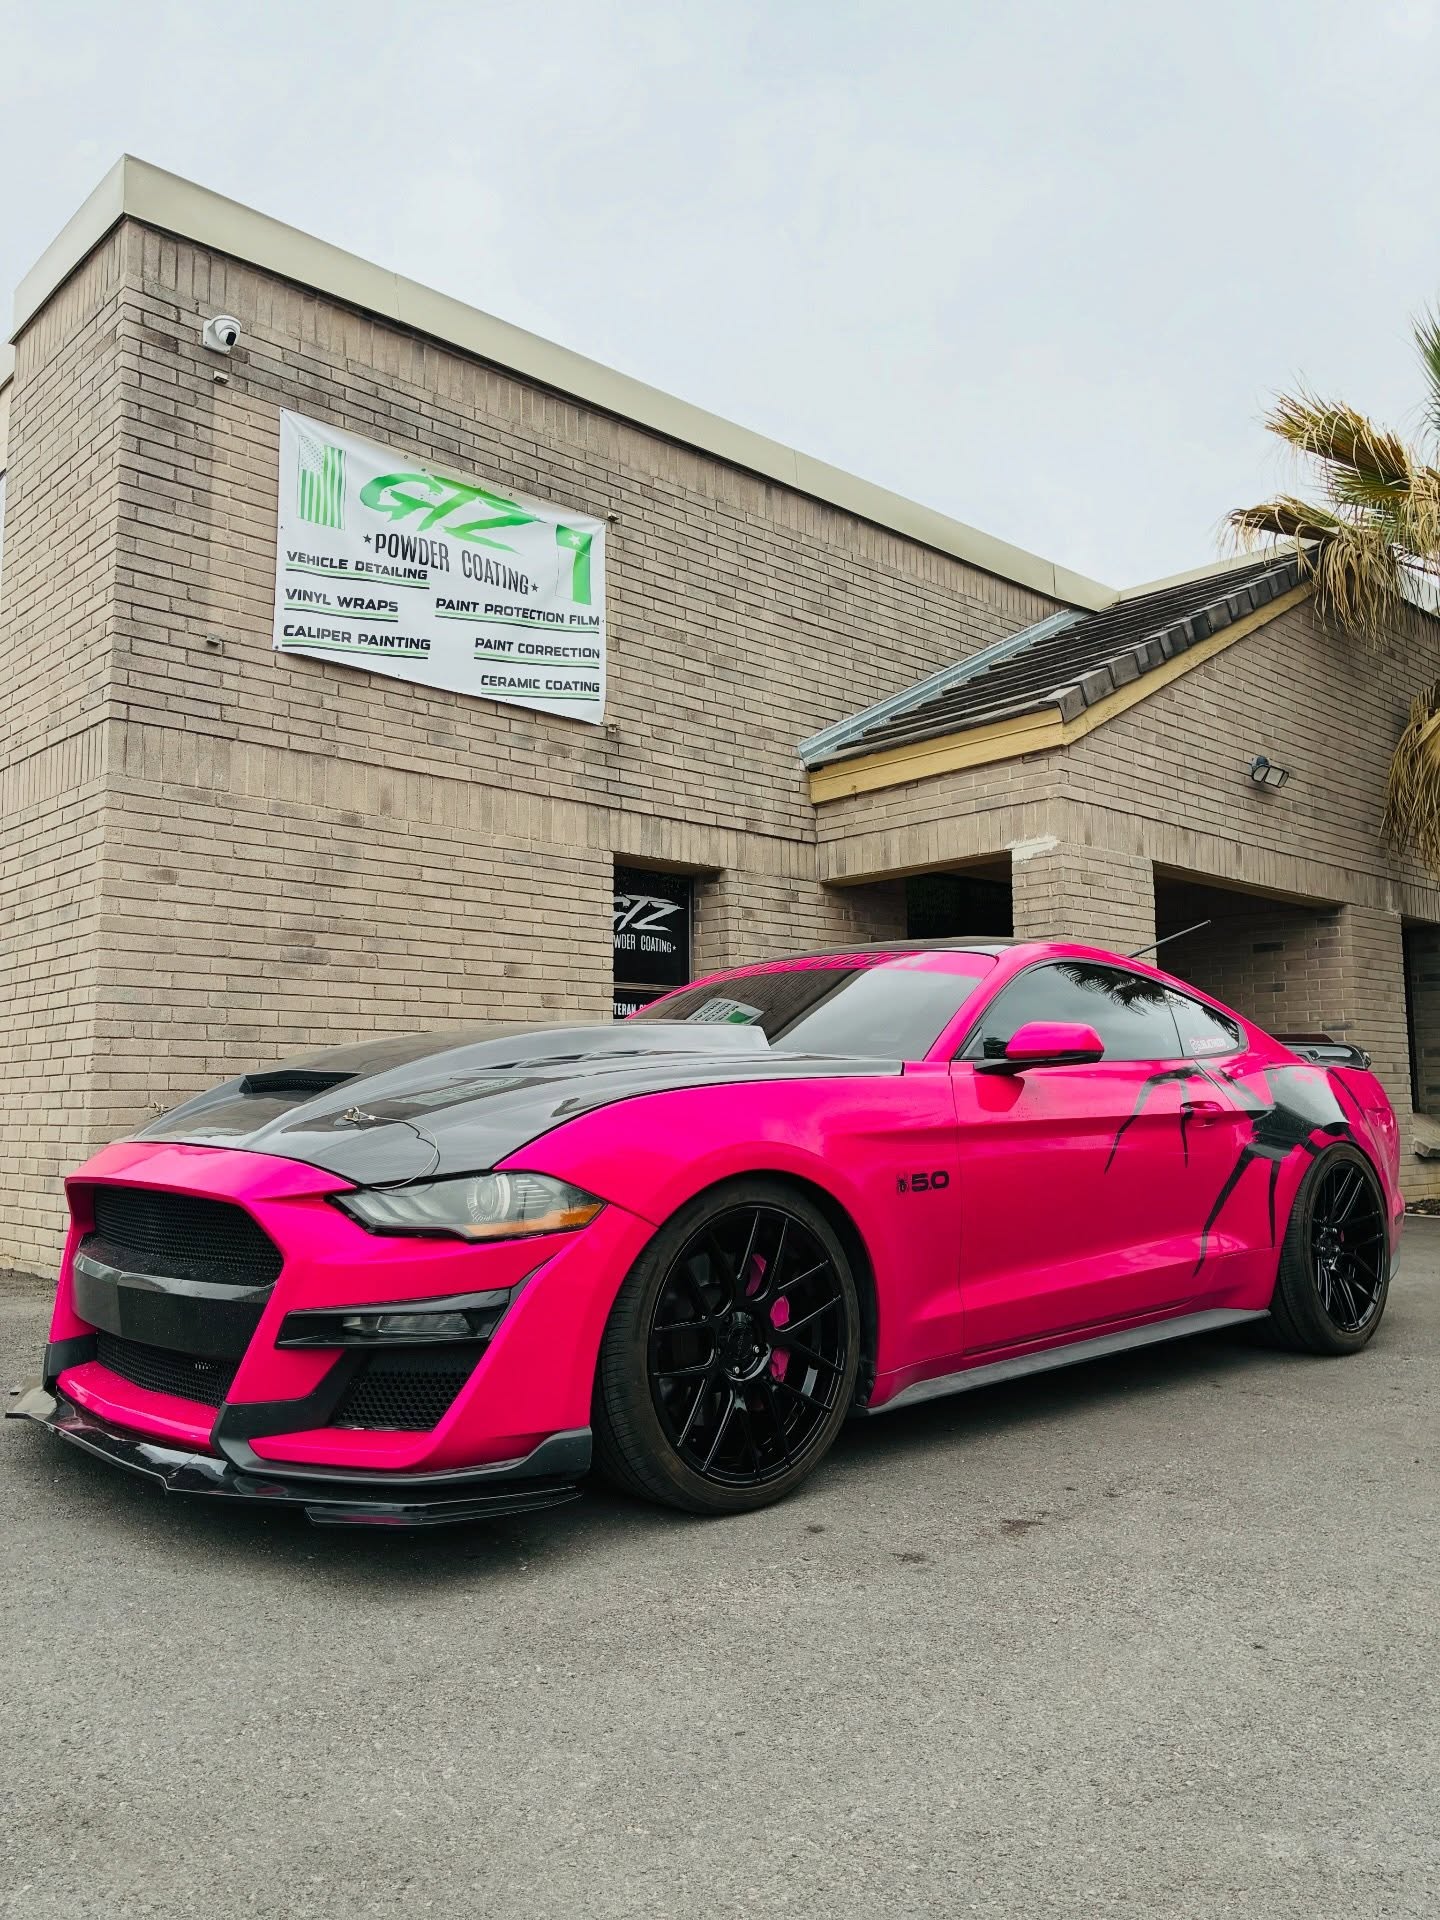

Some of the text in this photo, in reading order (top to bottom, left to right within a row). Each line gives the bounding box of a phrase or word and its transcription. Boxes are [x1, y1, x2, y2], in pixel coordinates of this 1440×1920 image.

[286, 551, 428, 580] VEHICLE DETAILING
[374, 533, 529, 595] POWDER COATING
[285, 588, 399, 613] VINYL WRAPS
[435, 597, 600, 626] PAINT PROTECTION FILM
[283, 624, 431, 650] CALIPER PAINTING
[474, 637, 600, 659] PAINT CORRECTION
[480, 674, 600, 693] CERAMIC COATING
[613, 933, 672, 953] WDER COATING
[613, 1003, 637, 1016] TERAN
[911, 1170, 950, 1192] 5.0
